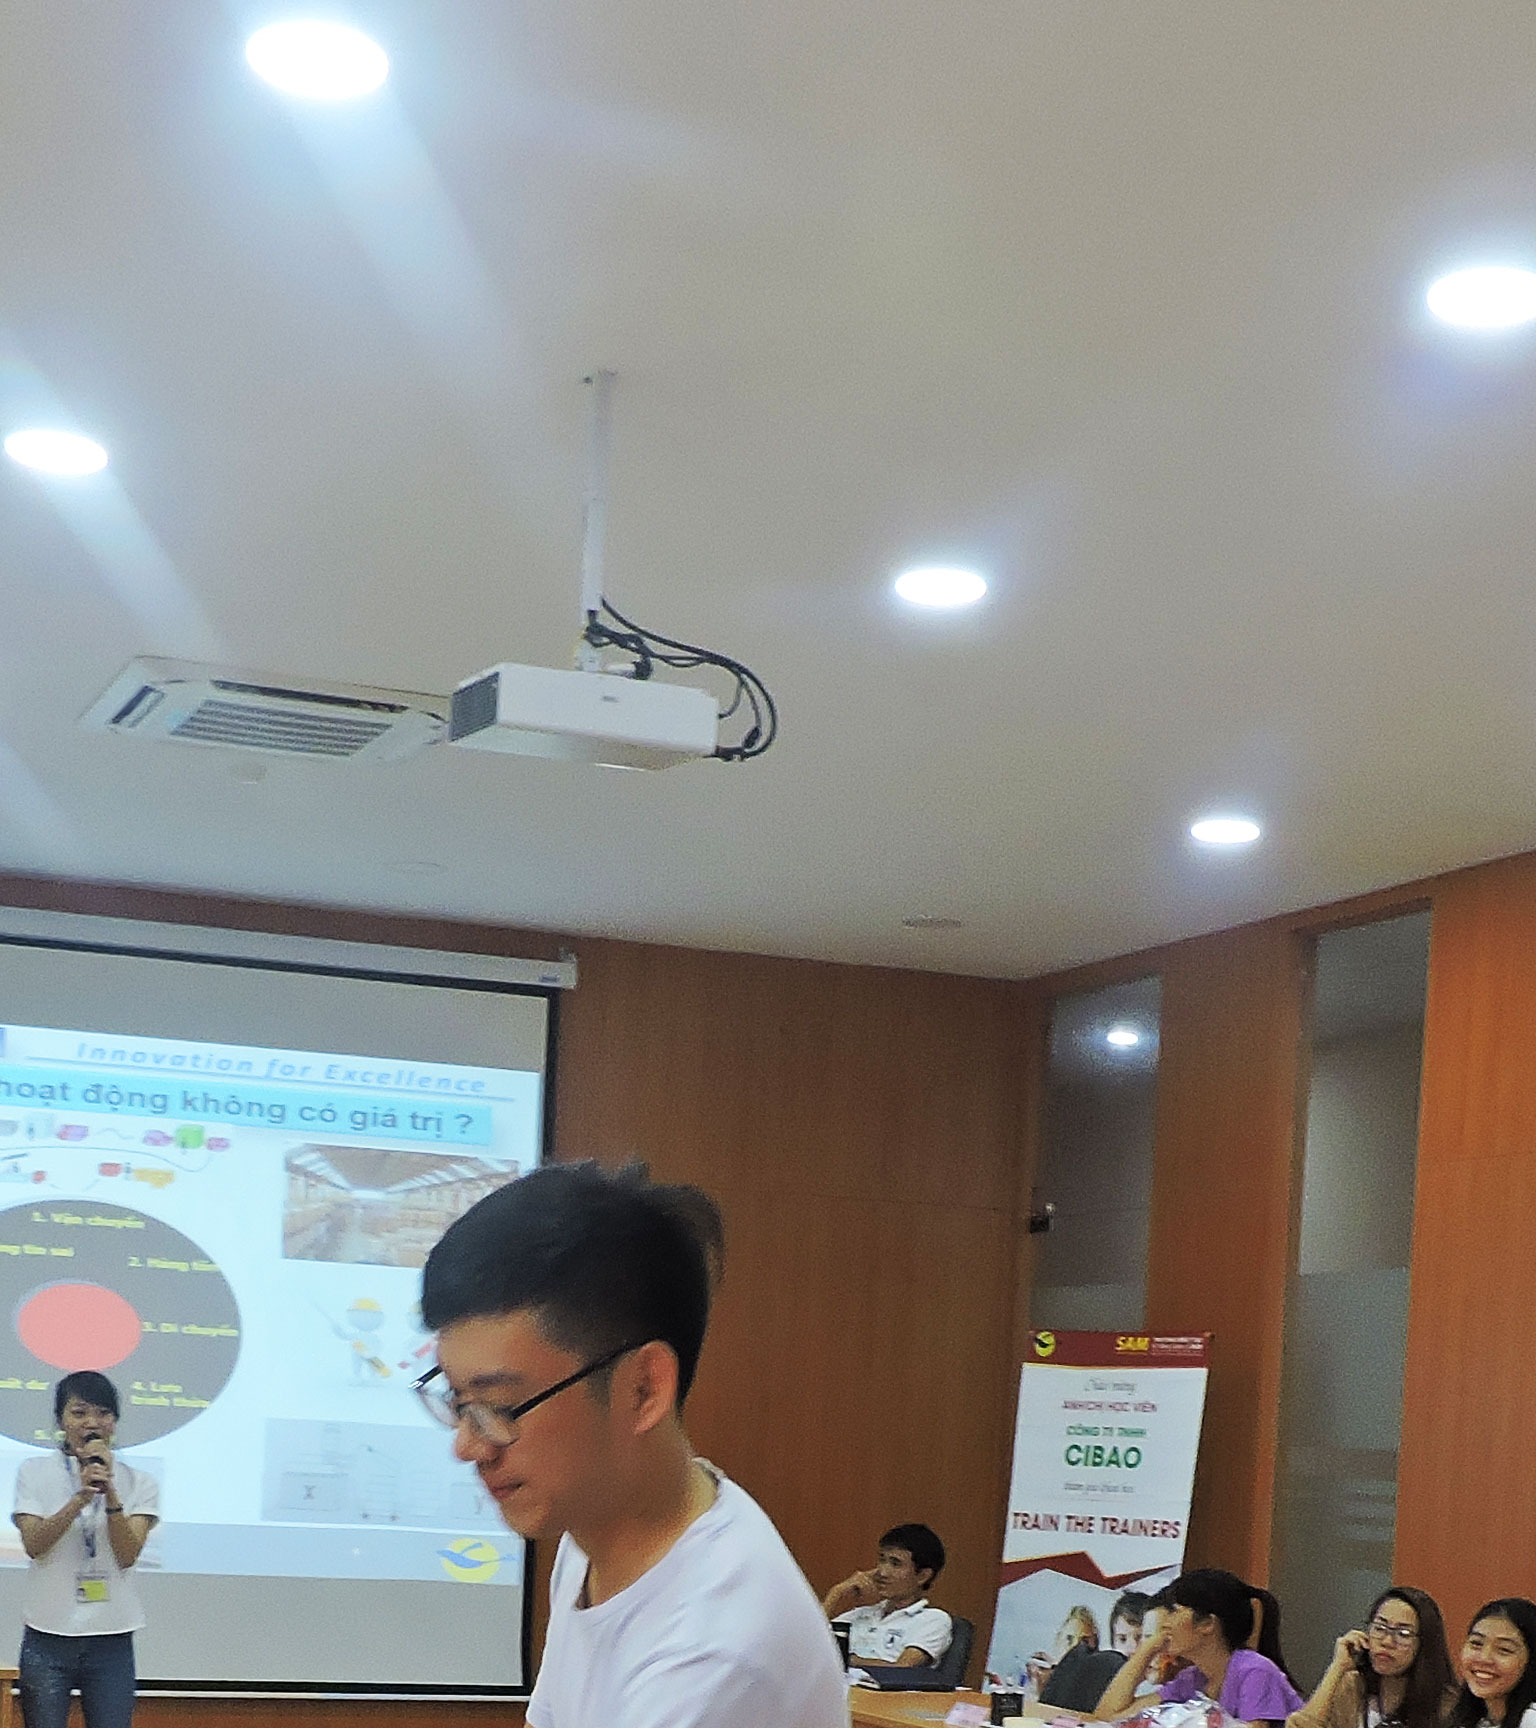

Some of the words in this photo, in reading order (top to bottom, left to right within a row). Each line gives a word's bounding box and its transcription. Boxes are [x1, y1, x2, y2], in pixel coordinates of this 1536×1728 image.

[76, 1042, 254, 1074] Innovation
[264, 1057, 312, 1082] for
[324, 1063, 486, 1094] Excellence
[83, 1081, 169, 1114] động
[298, 1102, 337, 1124] có
[350, 1106, 398, 1132] giá
[410, 1110, 443, 1139] trị
[458, 1113, 474, 1135] ?
[1065, 1444, 1143, 1469] CIBAO
[1012, 1512, 1059, 1532] TRAIN
[1065, 1514, 1095, 1534] THE
[1100, 1516, 1181, 1539] TRAINERS
